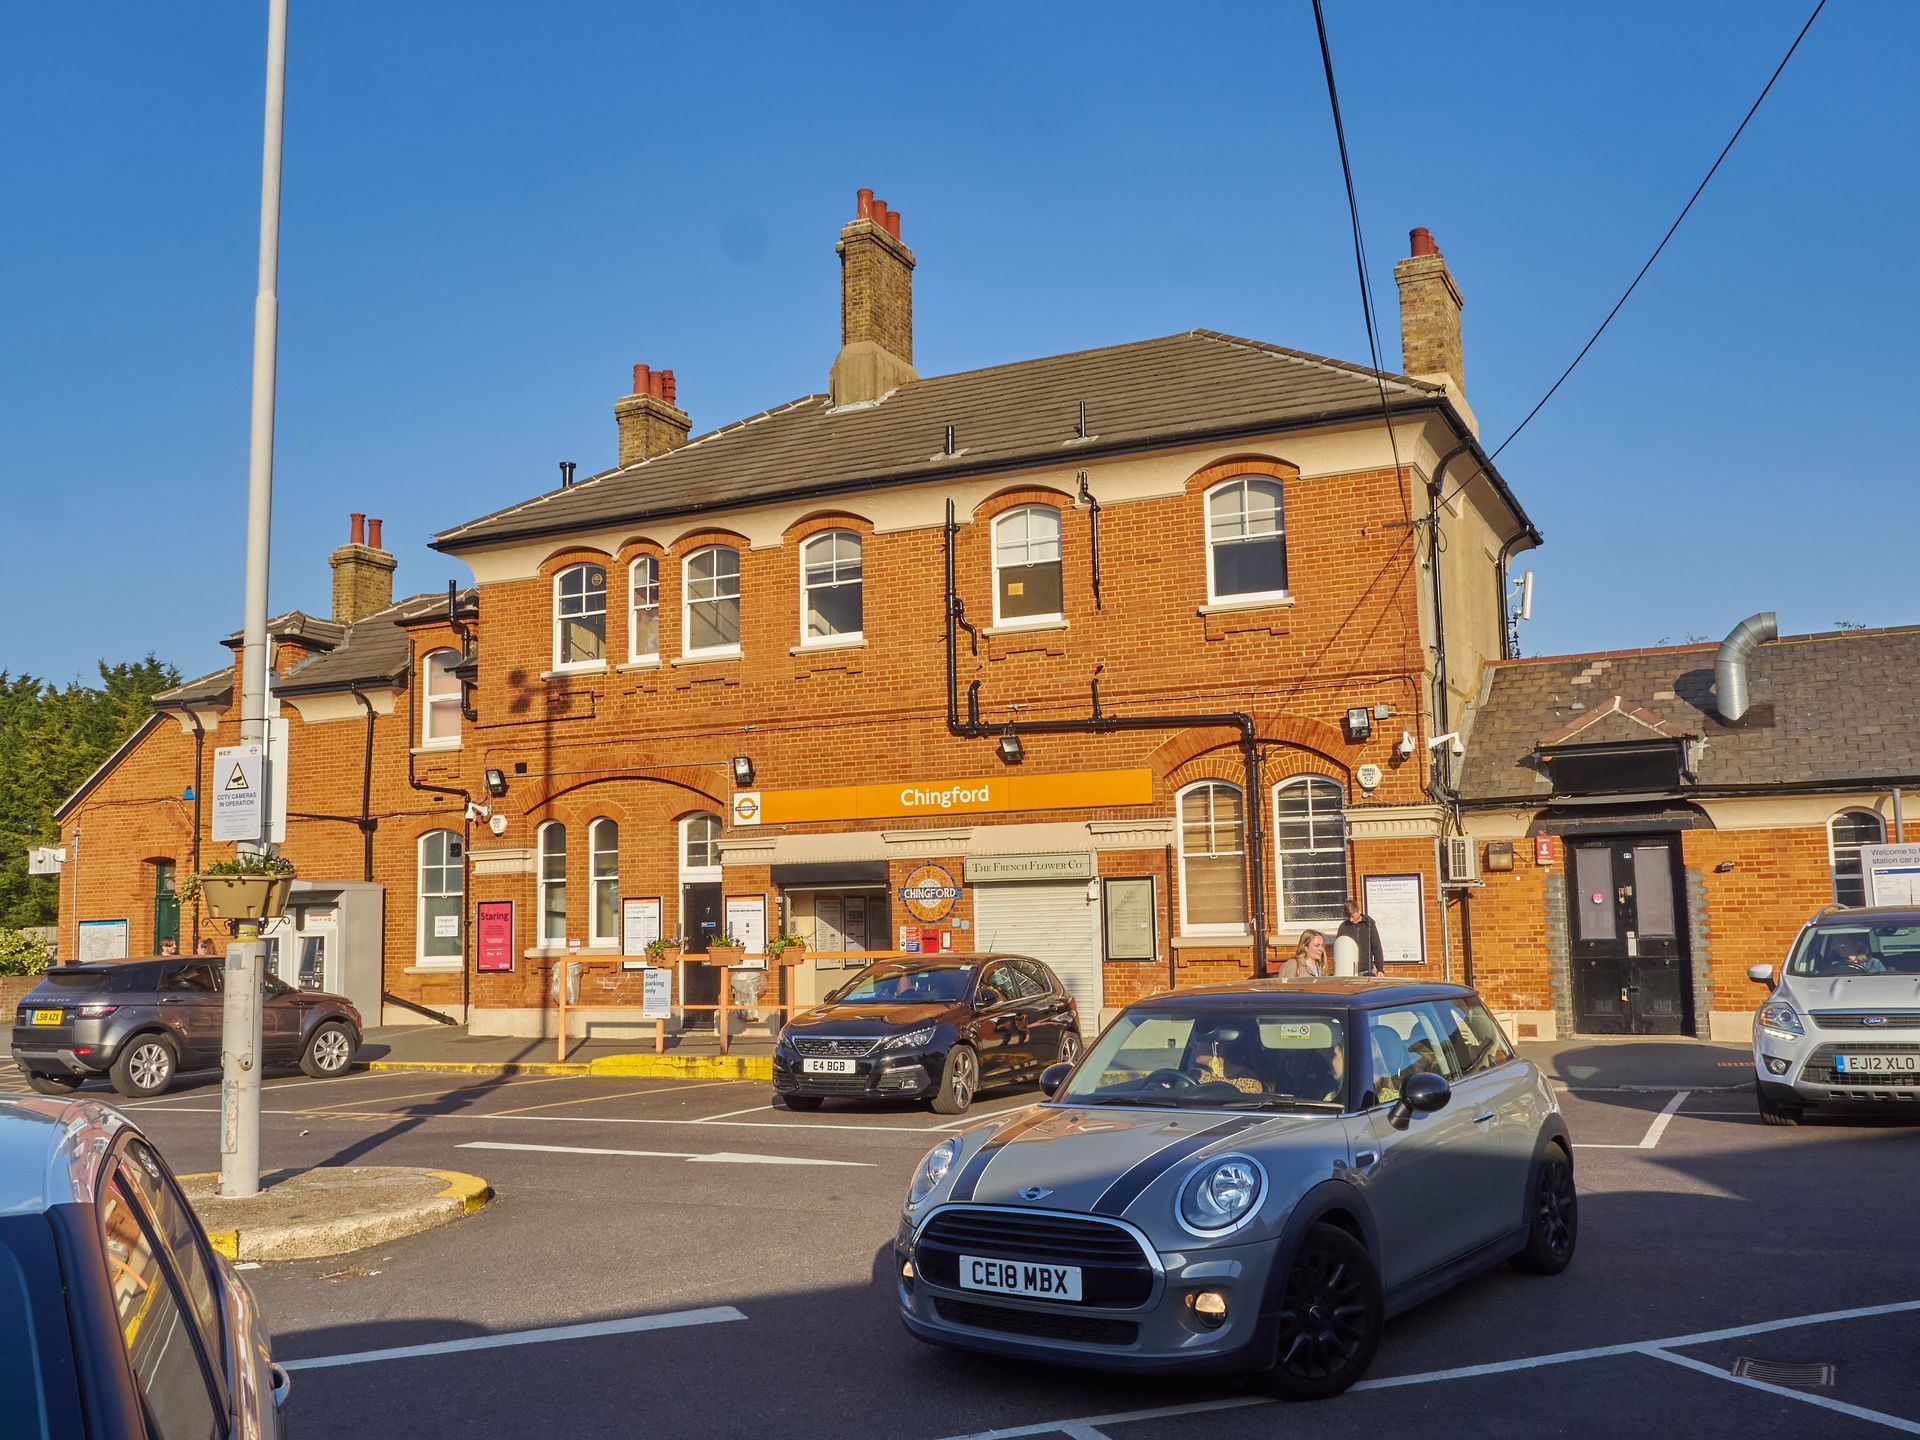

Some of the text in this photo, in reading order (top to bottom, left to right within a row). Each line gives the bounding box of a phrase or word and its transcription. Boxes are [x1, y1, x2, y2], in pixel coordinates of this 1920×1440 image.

[231, 792, 257, 800] CAMERAS
[901, 785, 989, 808] Chingford
[1871, 848, 1907, 856] Welcome
[904, 888, 956, 898] CHINGFORD
[480, 911, 509, 922] Staring
[813, 1060, 846, 1071] E4 BGB
[1850, 1057, 1915, 1070] EJ12 XLO
[972, 1261, 1068, 1294] CE18 MBX
